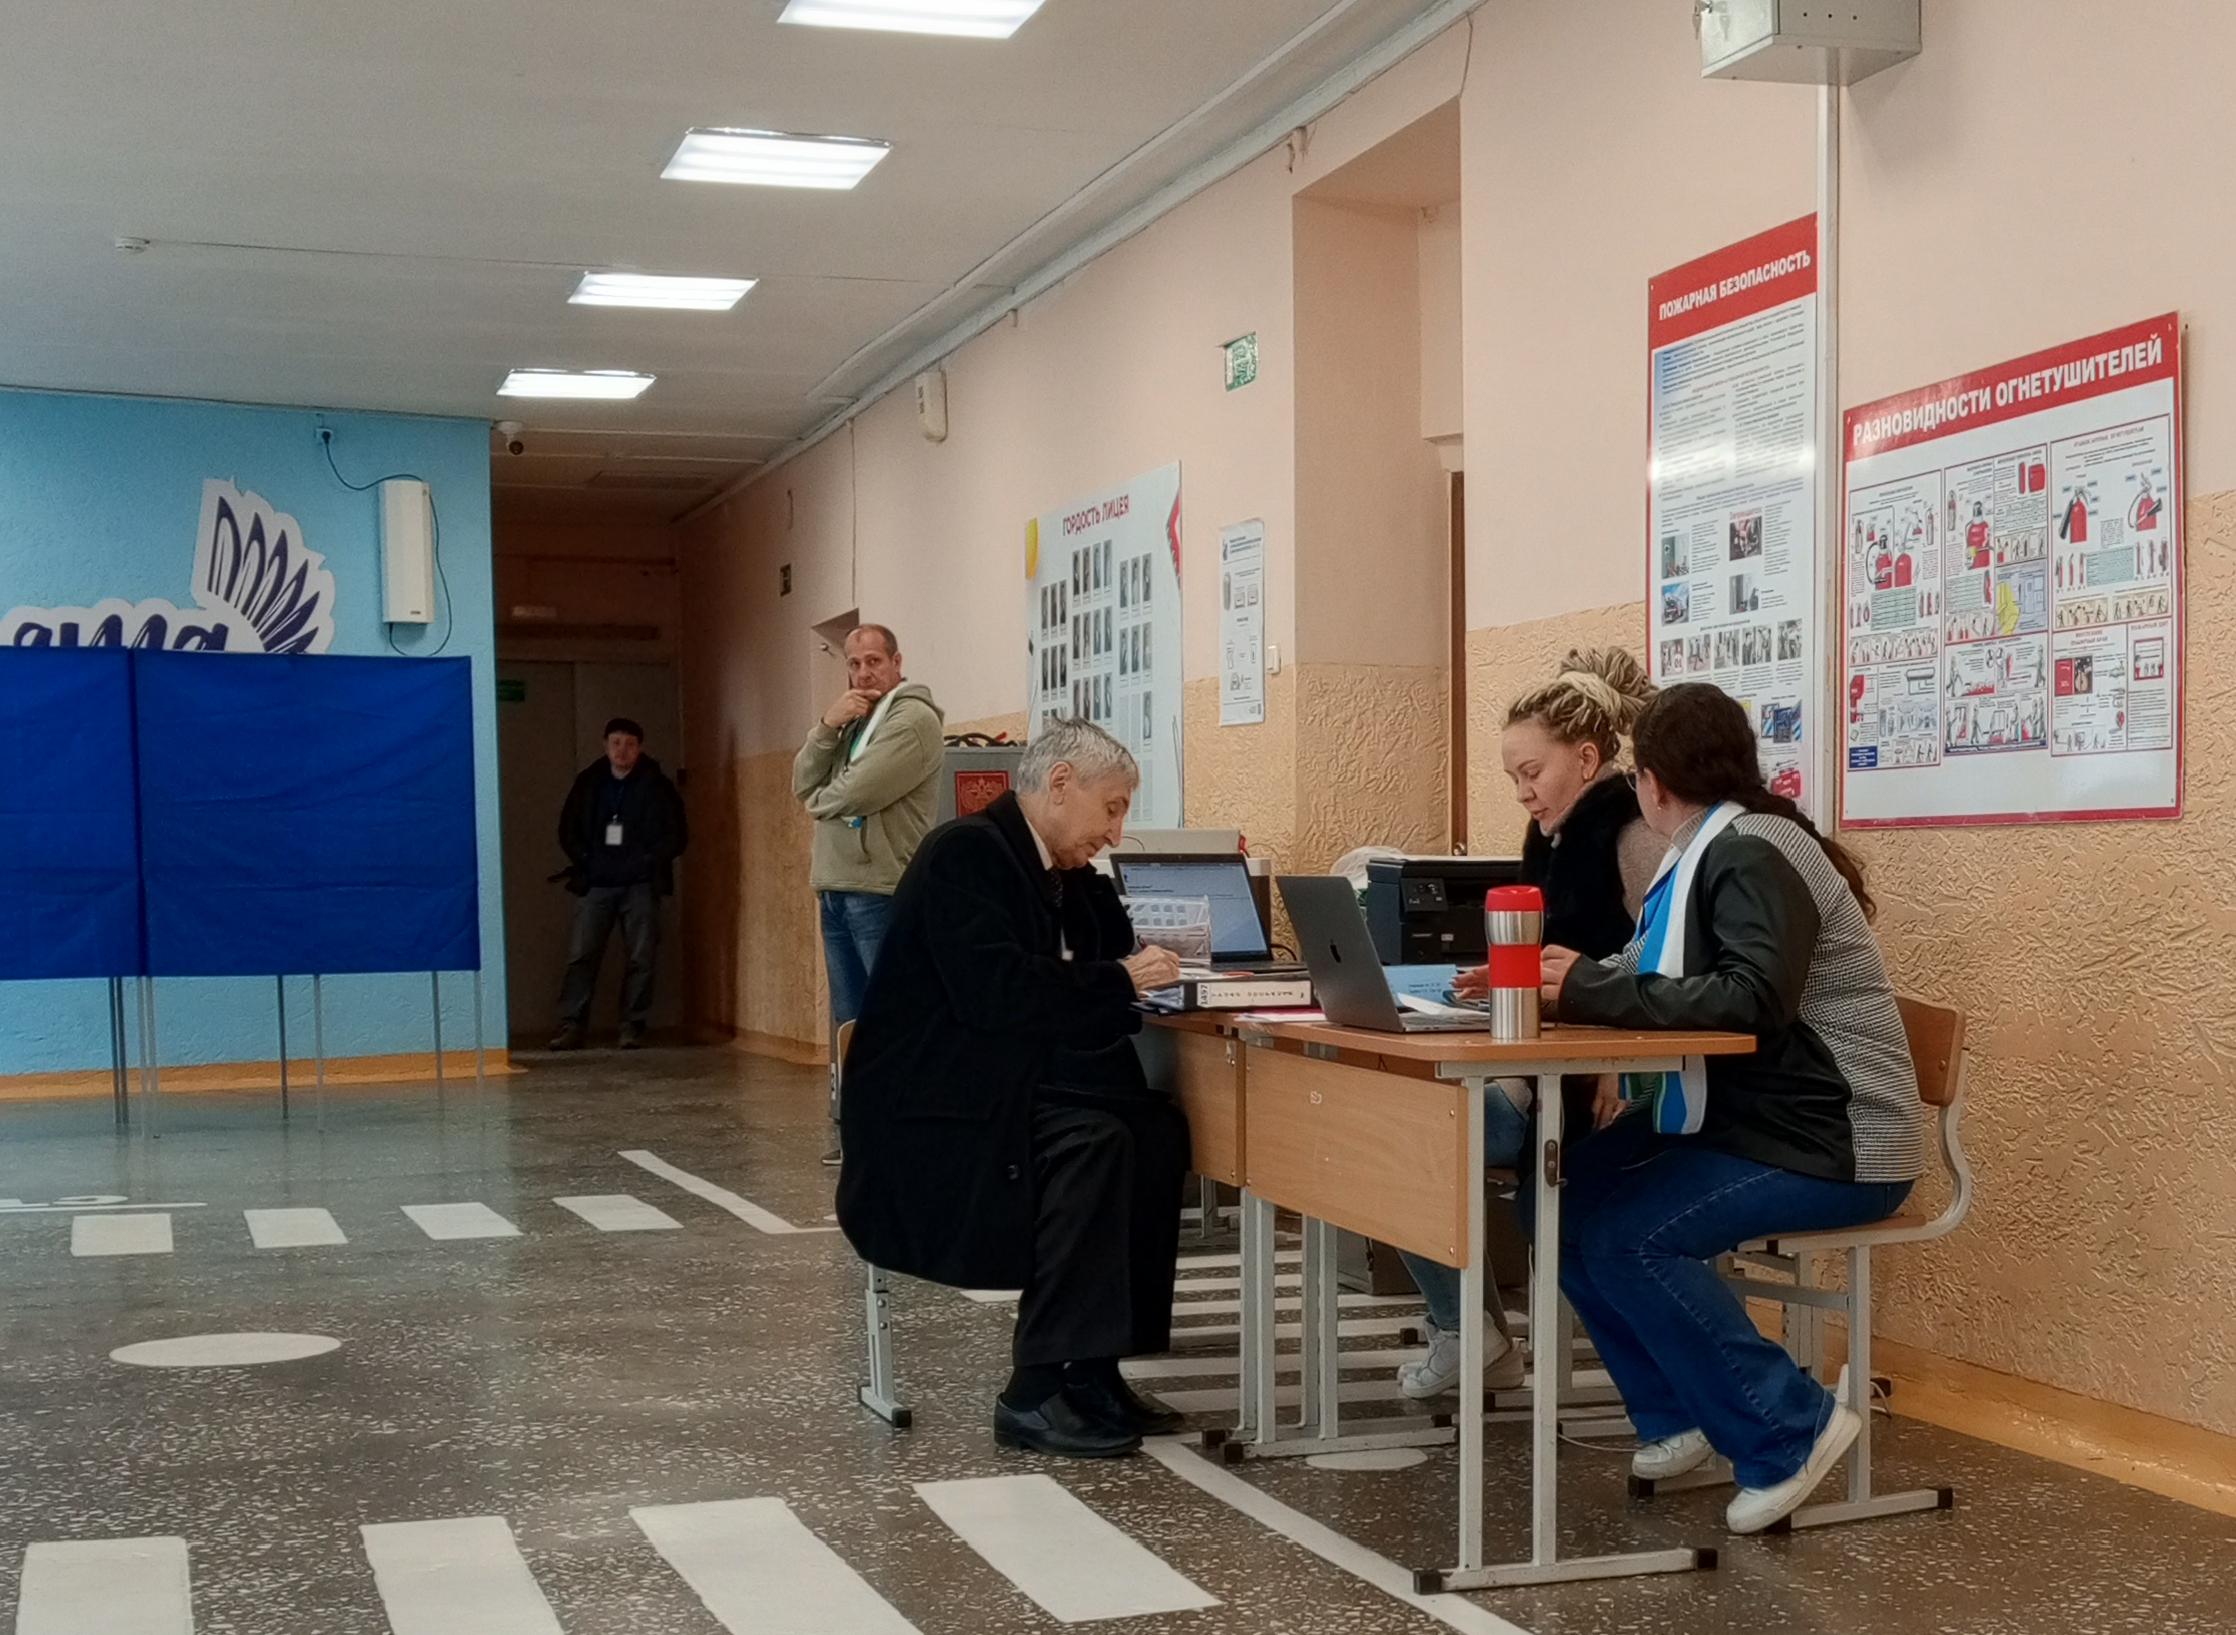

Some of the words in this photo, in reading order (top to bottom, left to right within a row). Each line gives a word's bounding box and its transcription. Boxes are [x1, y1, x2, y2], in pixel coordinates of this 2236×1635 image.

[1659, 284, 1717, 321] ПОЖАРНАЯ
[1719, 249, 1811, 299] БЕЗОПАСНОСТЬ
[1853, 386, 1992, 446] РАЗНОВИДНОСТИ
[1995, 332, 2163, 408] ОГНЕТУШИТЕЛЕЙ
[1062, 506, 1101, 536] ГОРДОСТЬ
[1102, 494, 1130, 523] ЛИЦЕЯ
